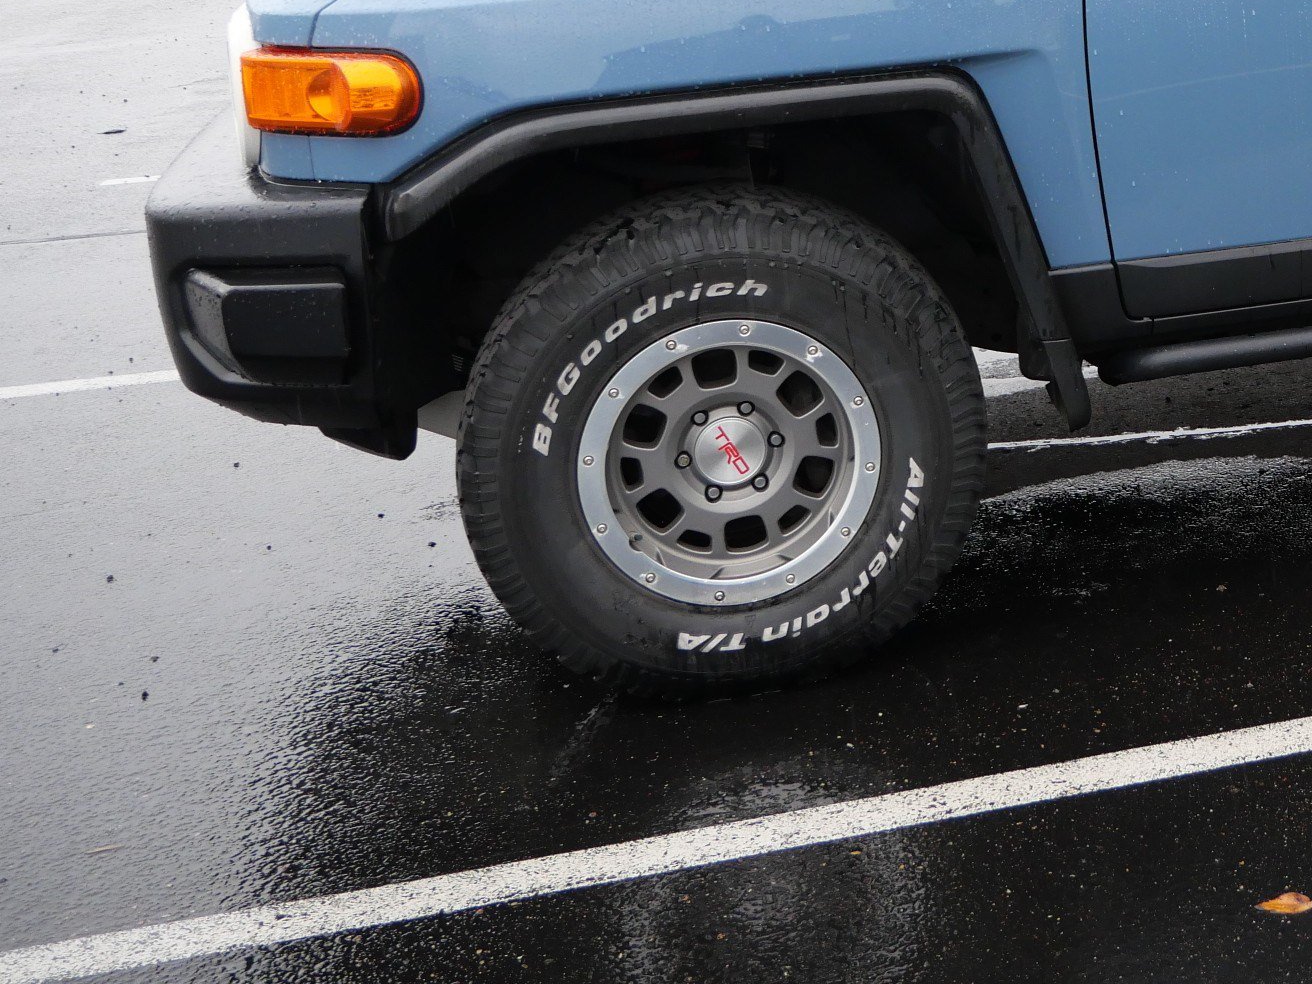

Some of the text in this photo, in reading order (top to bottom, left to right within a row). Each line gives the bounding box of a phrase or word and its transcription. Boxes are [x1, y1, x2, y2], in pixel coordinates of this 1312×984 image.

[533, 279, 769, 456] BFGoodrich
[715, 426, 750, 475] TRD
[676, 456, 925, 652] All-Terrain T/A
